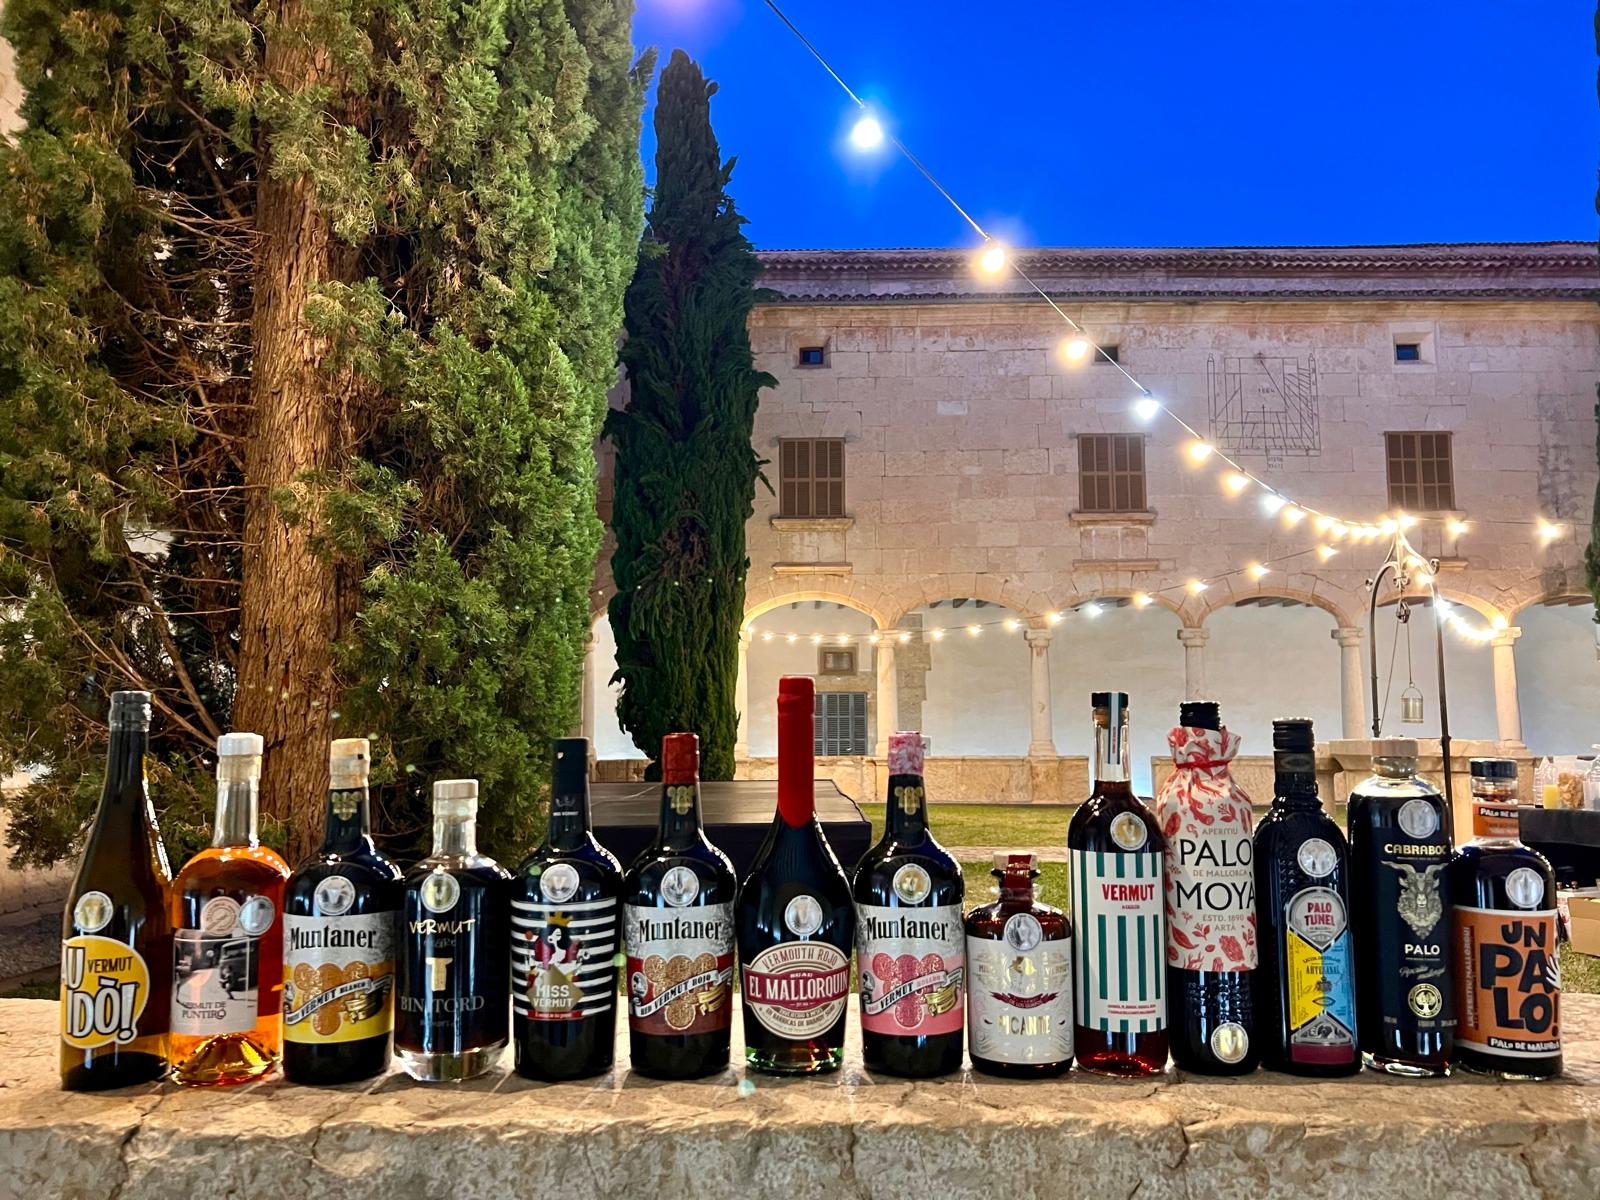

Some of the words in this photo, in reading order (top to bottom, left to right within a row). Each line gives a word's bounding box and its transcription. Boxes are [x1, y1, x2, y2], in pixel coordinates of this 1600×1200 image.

[1180, 839, 1251, 867] PALO
[1102, 884, 1155, 901] VERMUT
[1308, 902, 1332, 913] PALO
[639, 917, 721, 942] Muntaner
[867, 916, 949, 941] Muntaner
[1304, 914, 1335, 926] TUNEL
[290, 925, 377, 951] Muntaner
[1501, 920, 1546, 948] UN
[762, 947, 814, 970] VERMOUTH
[817, 948, 838, 966] ROJO
[1404, 944, 1440, 955] PALO
[87, 957, 134, 974] VERMUT
[1480, 943, 1556, 994] PA
[536, 984, 570, 998] MISS
[654, 981, 690, 1009] VERMUT
[749, 976, 761, 998] EL
[880, 982, 914, 1009] VERMUT
[301, 989, 337, 1017] VERMUT
[400, 996, 485, 1013] BINTORD
[533, 998, 574, 1008] VERMUT
[1493, 986, 1560, 1037] LO!
